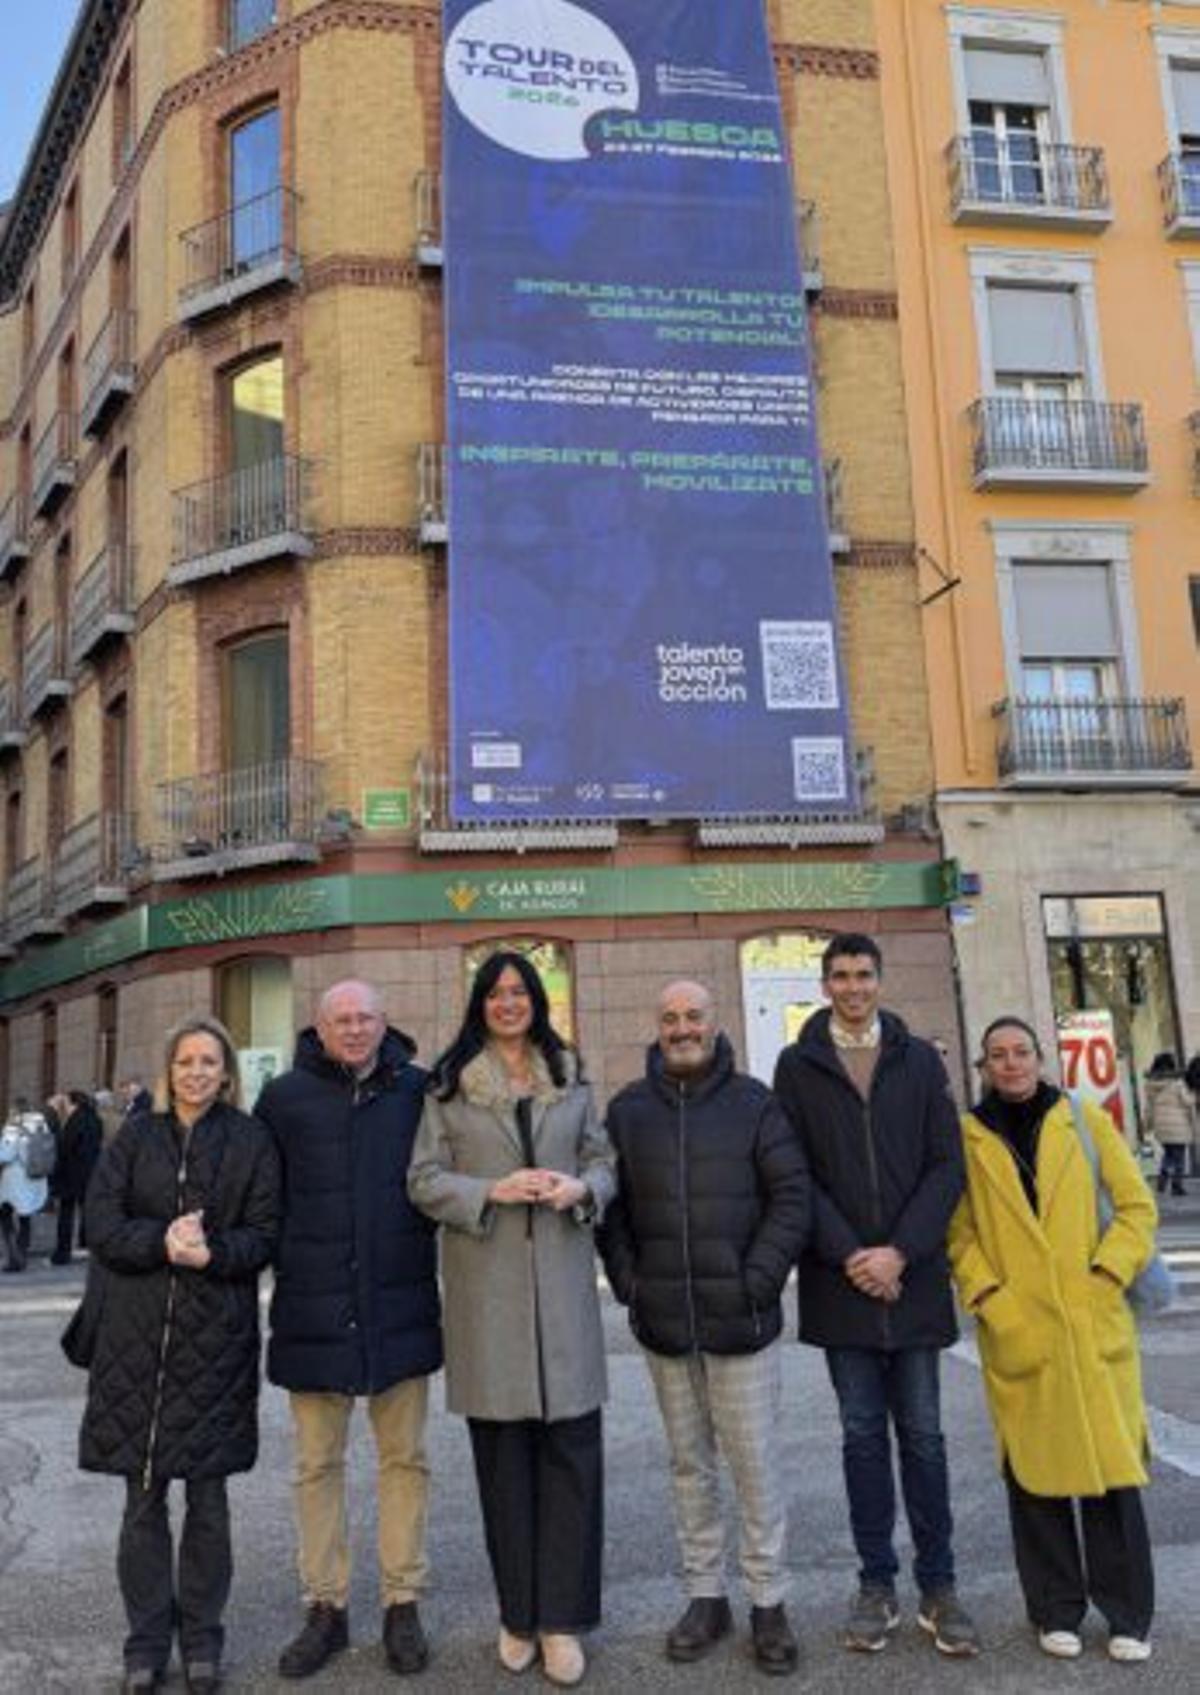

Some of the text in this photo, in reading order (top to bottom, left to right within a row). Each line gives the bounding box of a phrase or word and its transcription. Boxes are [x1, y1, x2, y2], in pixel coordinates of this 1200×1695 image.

[456, 38, 574, 72] TOUR
[579, 58, 626, 76] DEL
[457, 60, 628, 95] TALENTO
[602, 119, 778, 147] HUESCA
[657, 642, 744, 664] talento
[660, 664, 727, 685] joven
[486, 879, 531, 898] CAJA
[1058, 1036, 1117, 1089] 70
